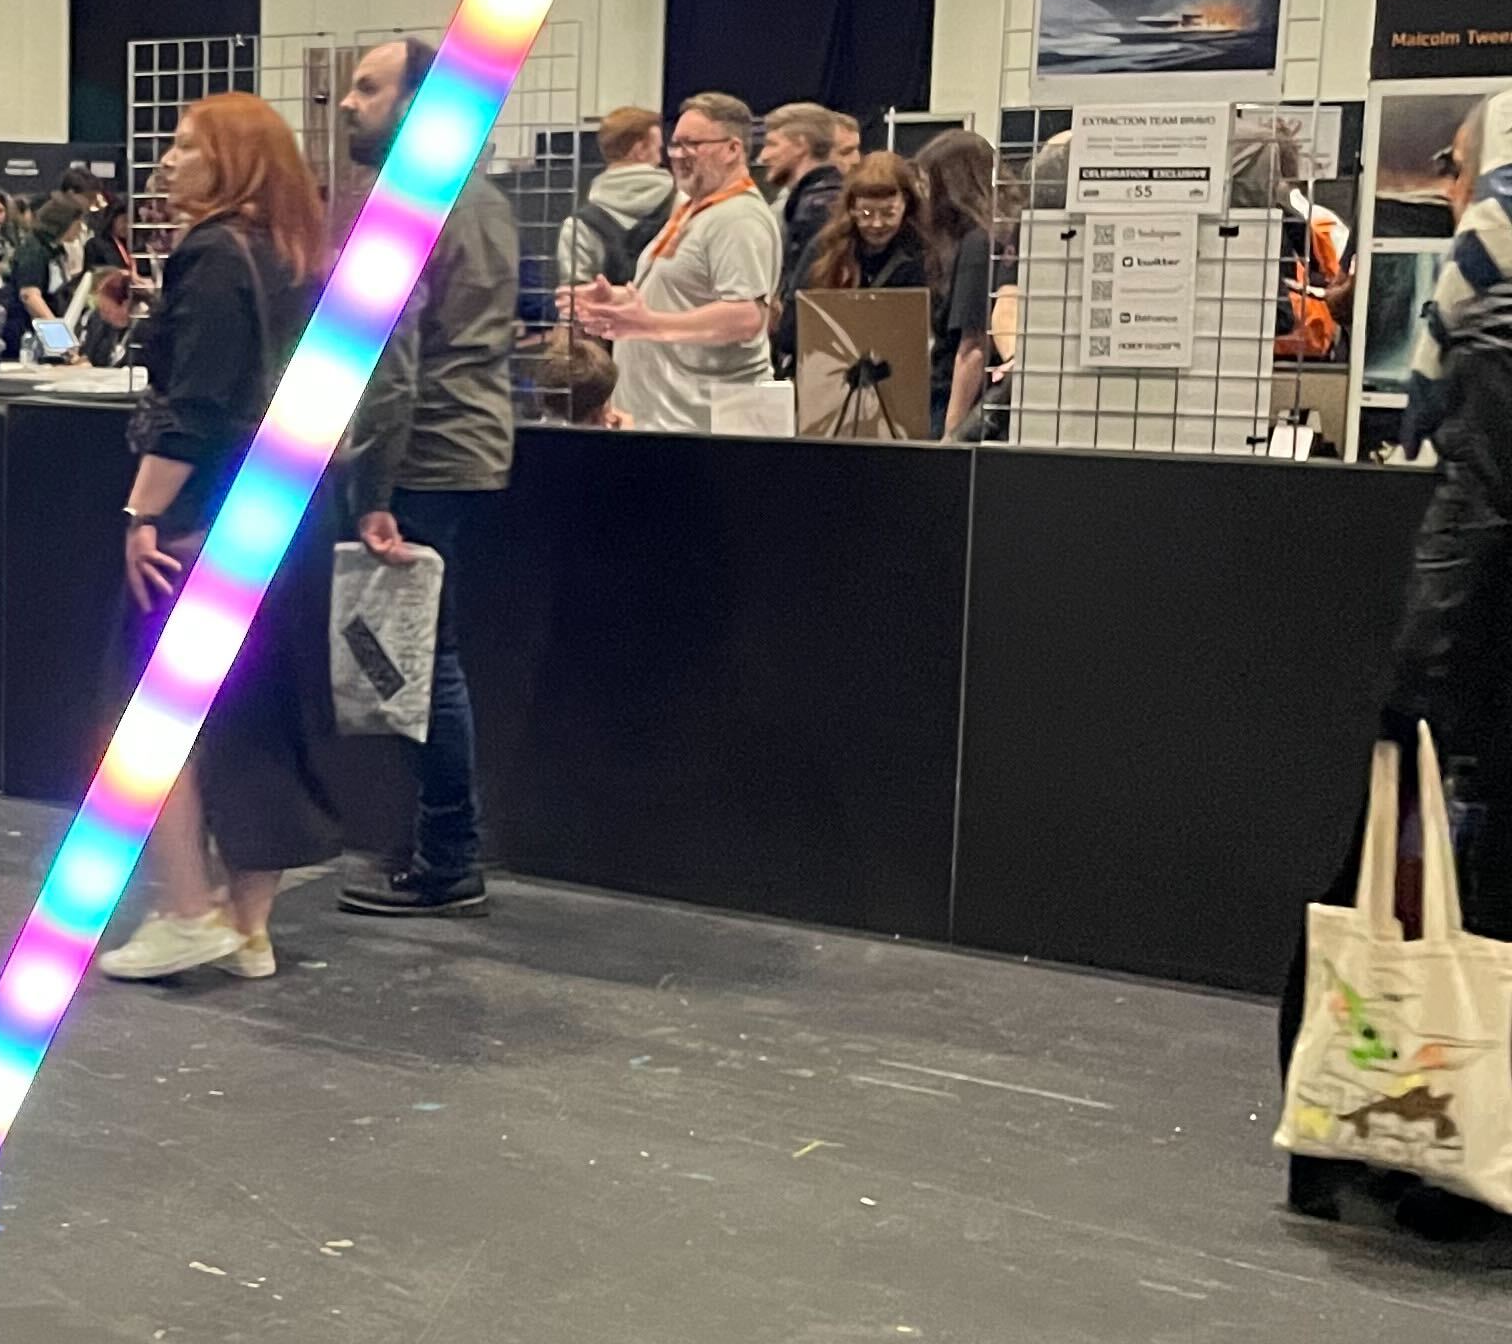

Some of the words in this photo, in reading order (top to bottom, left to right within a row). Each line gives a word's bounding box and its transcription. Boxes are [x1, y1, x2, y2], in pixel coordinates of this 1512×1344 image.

[1391, 31, 1461, 48] Malcolm
[1082, 115, 1148, 127] EXTRACTION
[1149, 115, 1178, 126] TEAM
[1180, 115, 1216, 126] BRAVO
[1081, 168, 1150, 179] CELEBRATION
[1152, 168, 1207, 179] EXCLUSIVE
